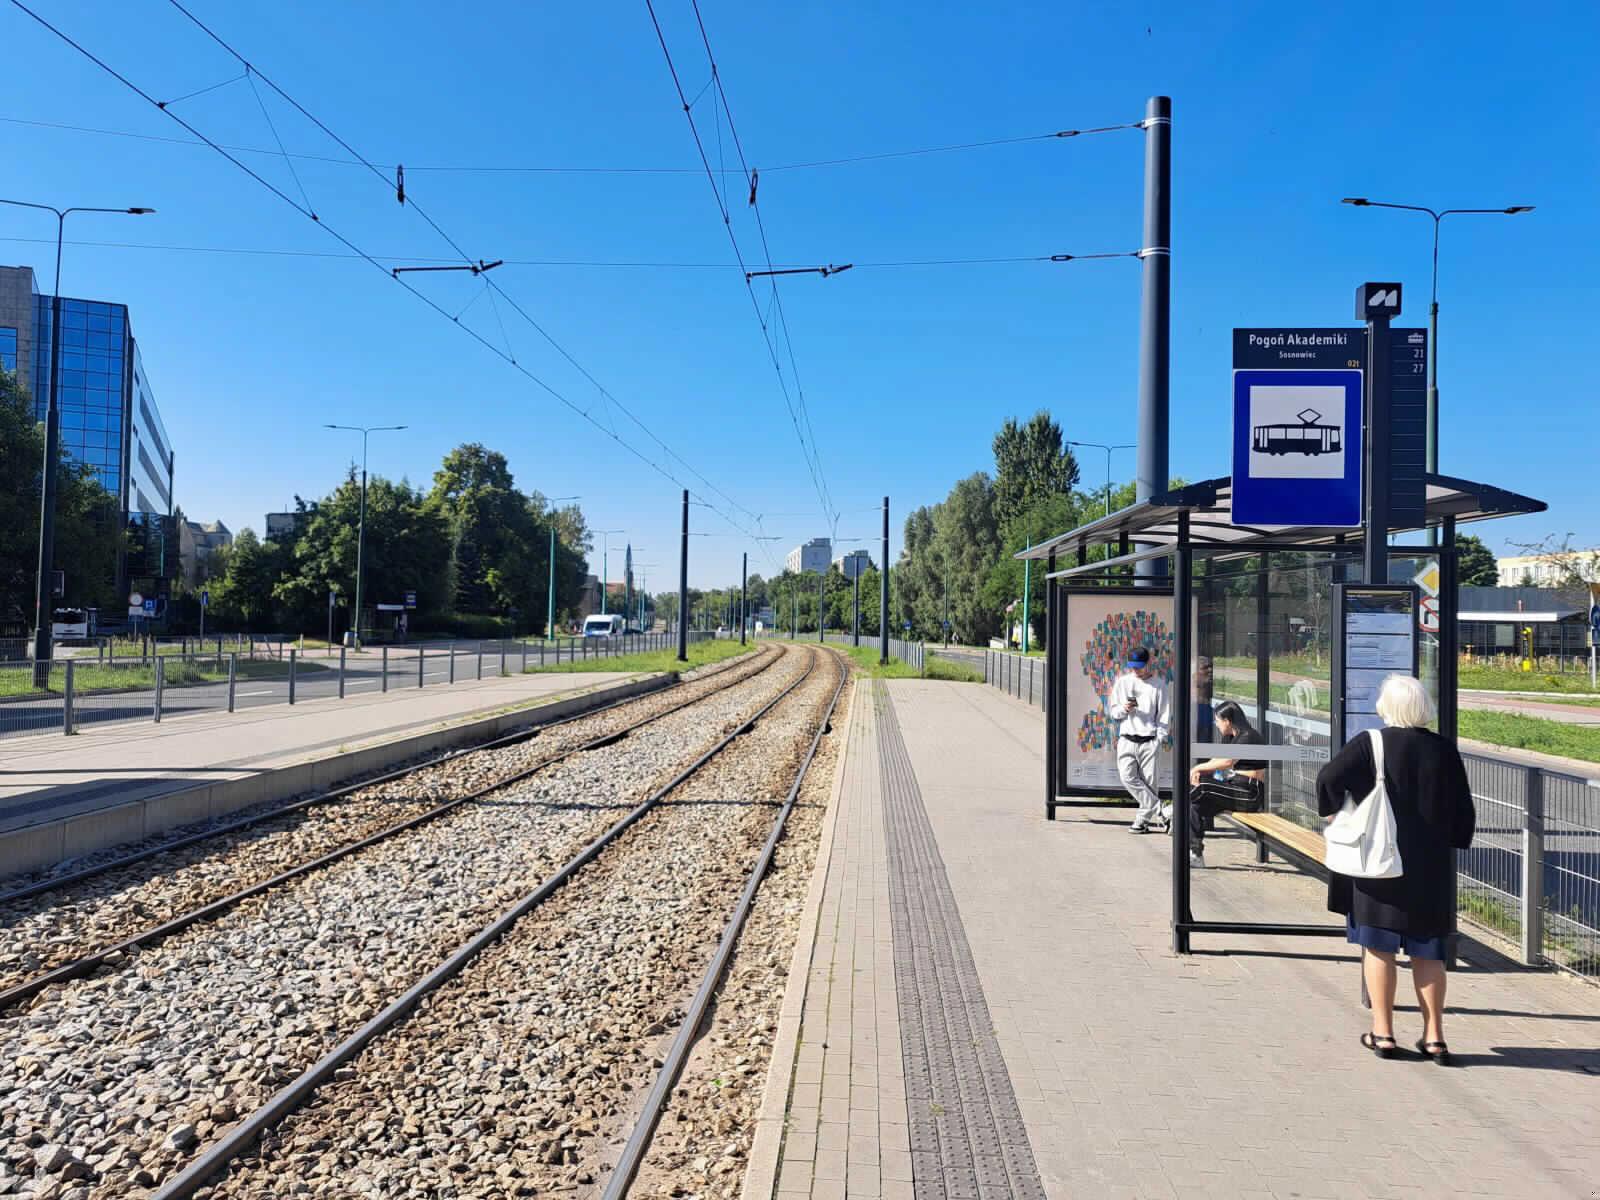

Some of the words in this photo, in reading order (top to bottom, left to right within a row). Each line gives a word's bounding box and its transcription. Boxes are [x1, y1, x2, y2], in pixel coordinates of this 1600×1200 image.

[1249, 334, 1284, 348] Pogoń
[1287, 333, 1348, 345] Akademiki
[1279, 351, 1317, 359] Sosnowiec
[1413, 349, 1424, 358] 21
[1413, 363, 1424, 373] 27
